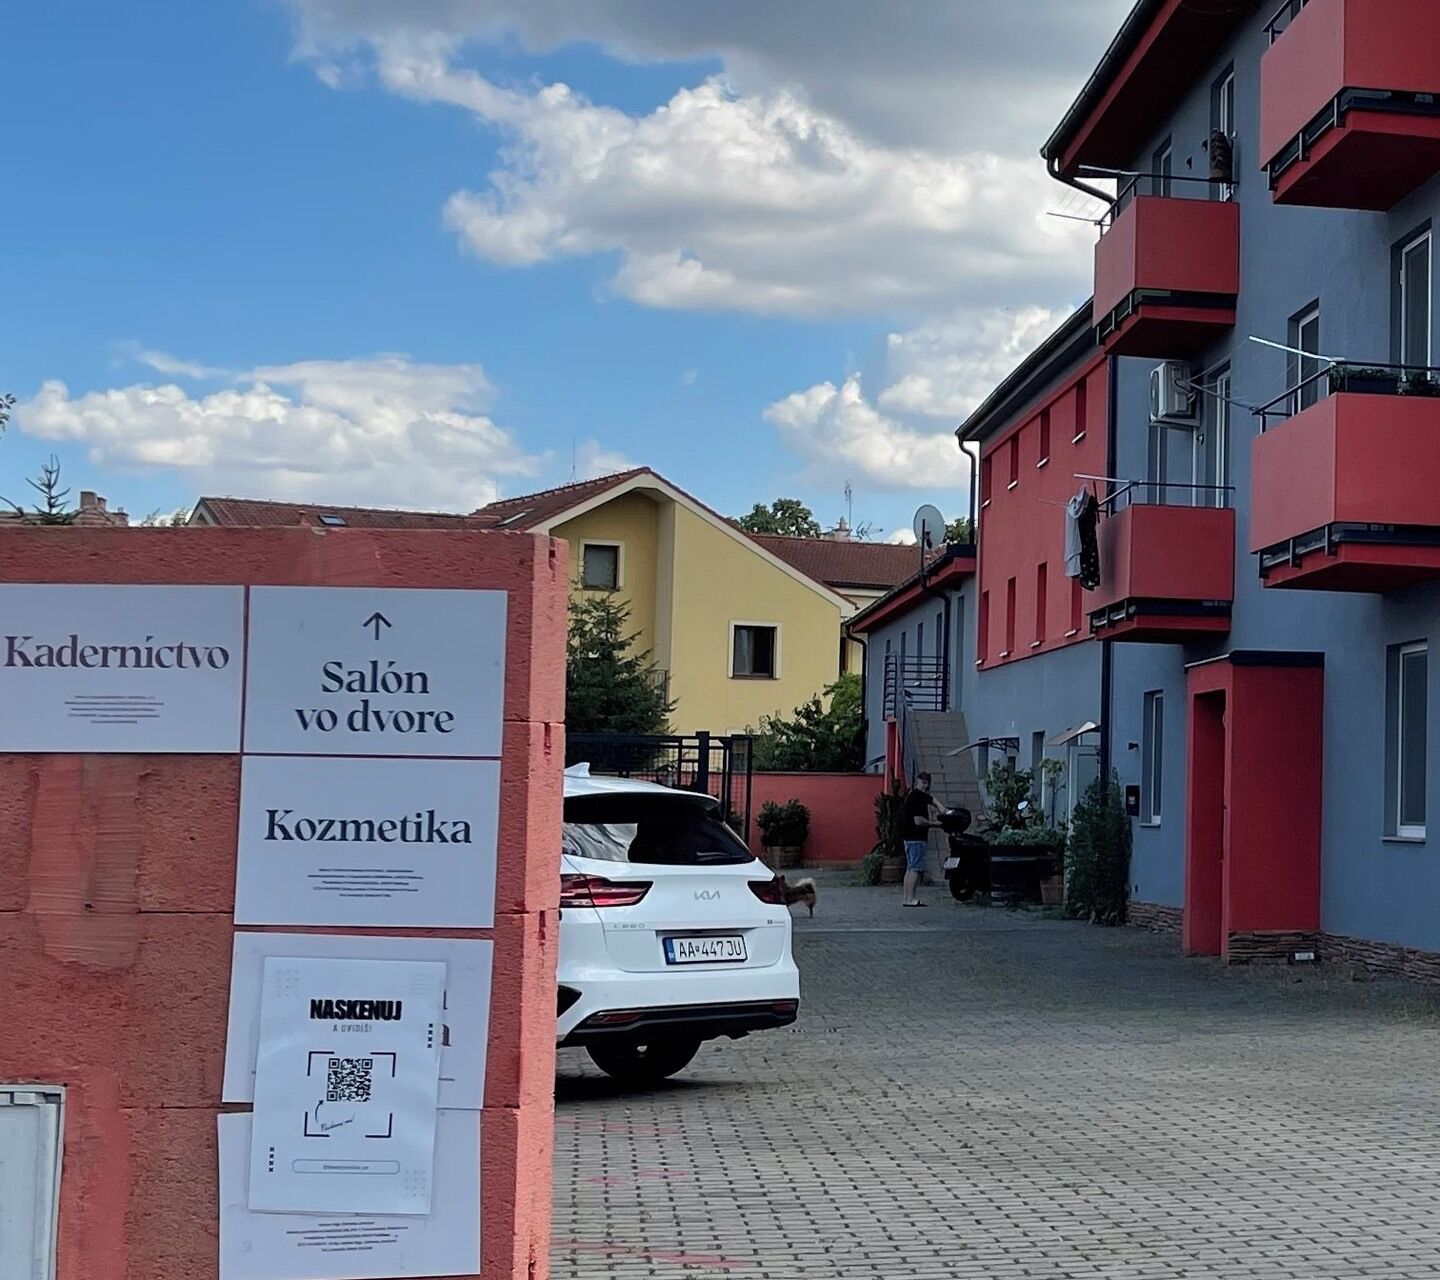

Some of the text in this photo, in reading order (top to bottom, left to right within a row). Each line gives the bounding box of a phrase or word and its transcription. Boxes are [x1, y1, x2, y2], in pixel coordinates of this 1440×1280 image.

[3, 634, 230, 669] Kaderníctvo
[321, 660, 430, 694] Salón
[294, 699, 455, 733] vo dvore
[264, 809, 473, 843] Kozmetika
[309, 999, 403, 1021] NASKENUJ
